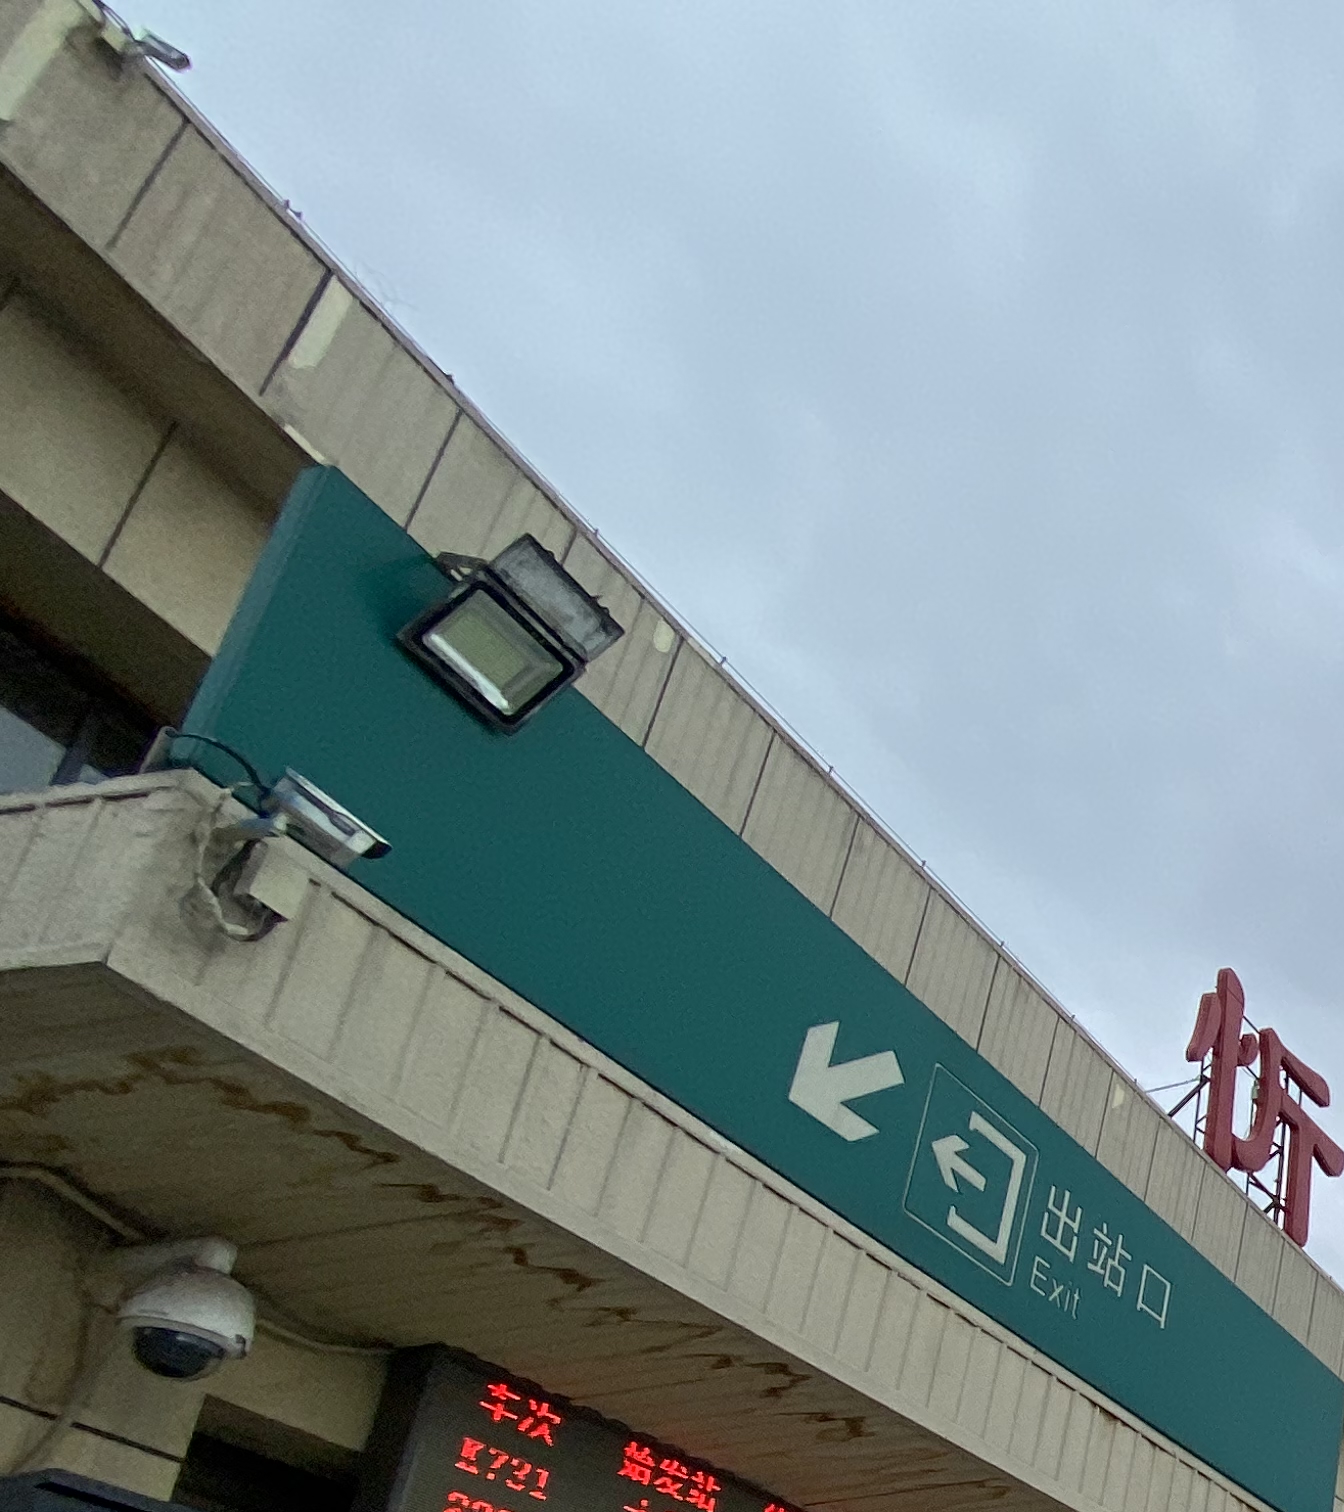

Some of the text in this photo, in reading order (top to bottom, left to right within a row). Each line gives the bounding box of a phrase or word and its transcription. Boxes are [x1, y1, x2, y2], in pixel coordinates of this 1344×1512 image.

[1030, 1256, 1081, 1319] Exit
[1041, 1184, 1172, 1329] 出站口
[480, 1383, 561, 1447] 车次
[617, 1441, 721, 1512] 始发站
